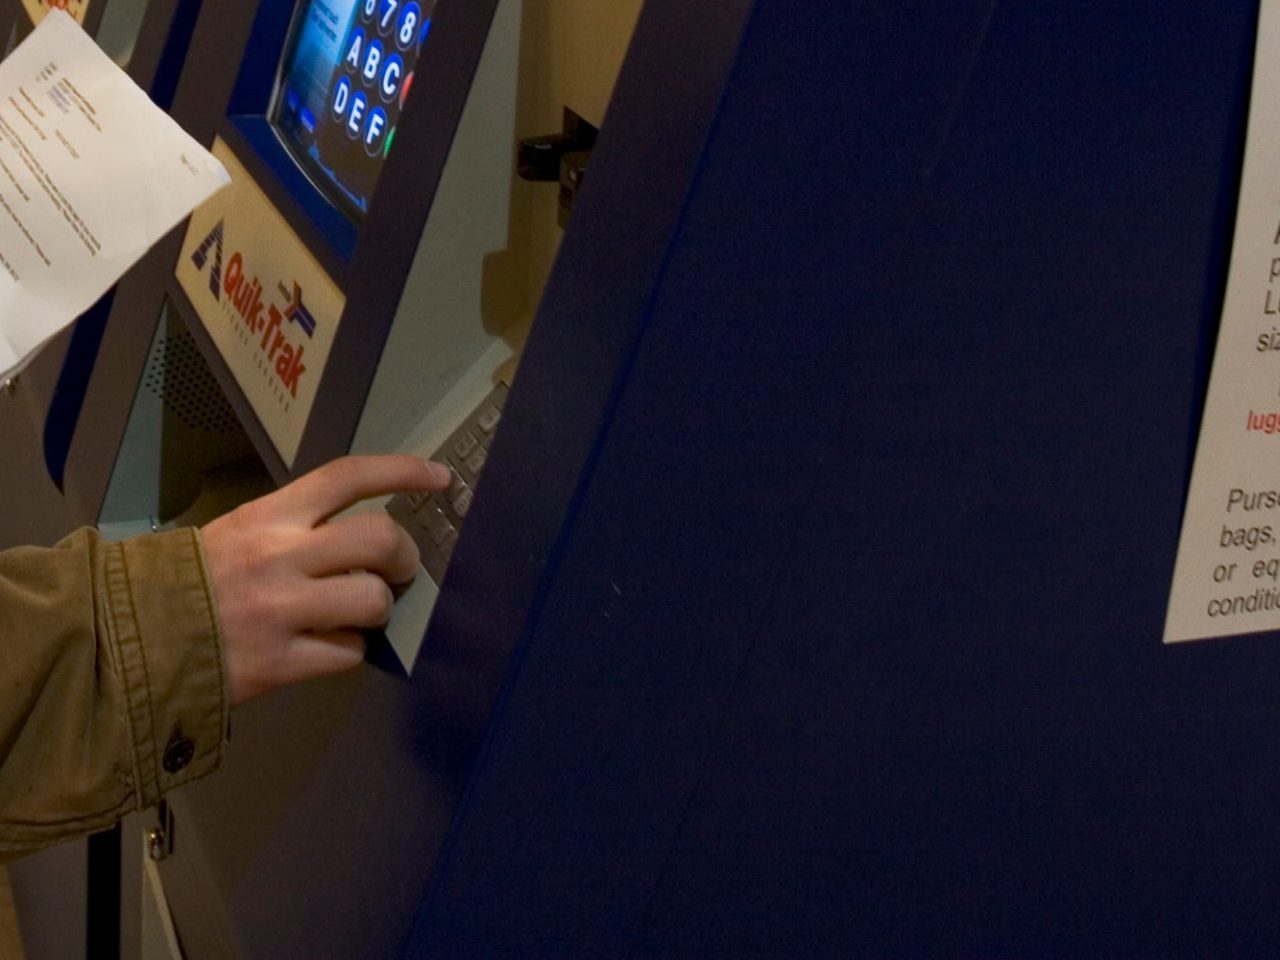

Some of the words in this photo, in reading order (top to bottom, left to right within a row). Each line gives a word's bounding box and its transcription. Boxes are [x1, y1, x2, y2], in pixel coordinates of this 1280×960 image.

[399, 10, 417, 43] 8
[346, 35, 363, 67] A
[363, 46, 381, 79] B
[382, 61, 400, 95] C
[333, 82, 349, 114] D
[349, 97, 365, 132] E
[366, 113, 384, 145] F
[223, 251, 306, 400] Quik-Trak
[1246, 409, 1280, 434] lug
[1226, 487, 1280, 513] Purs
[1213, 562, 1238, 583] or
